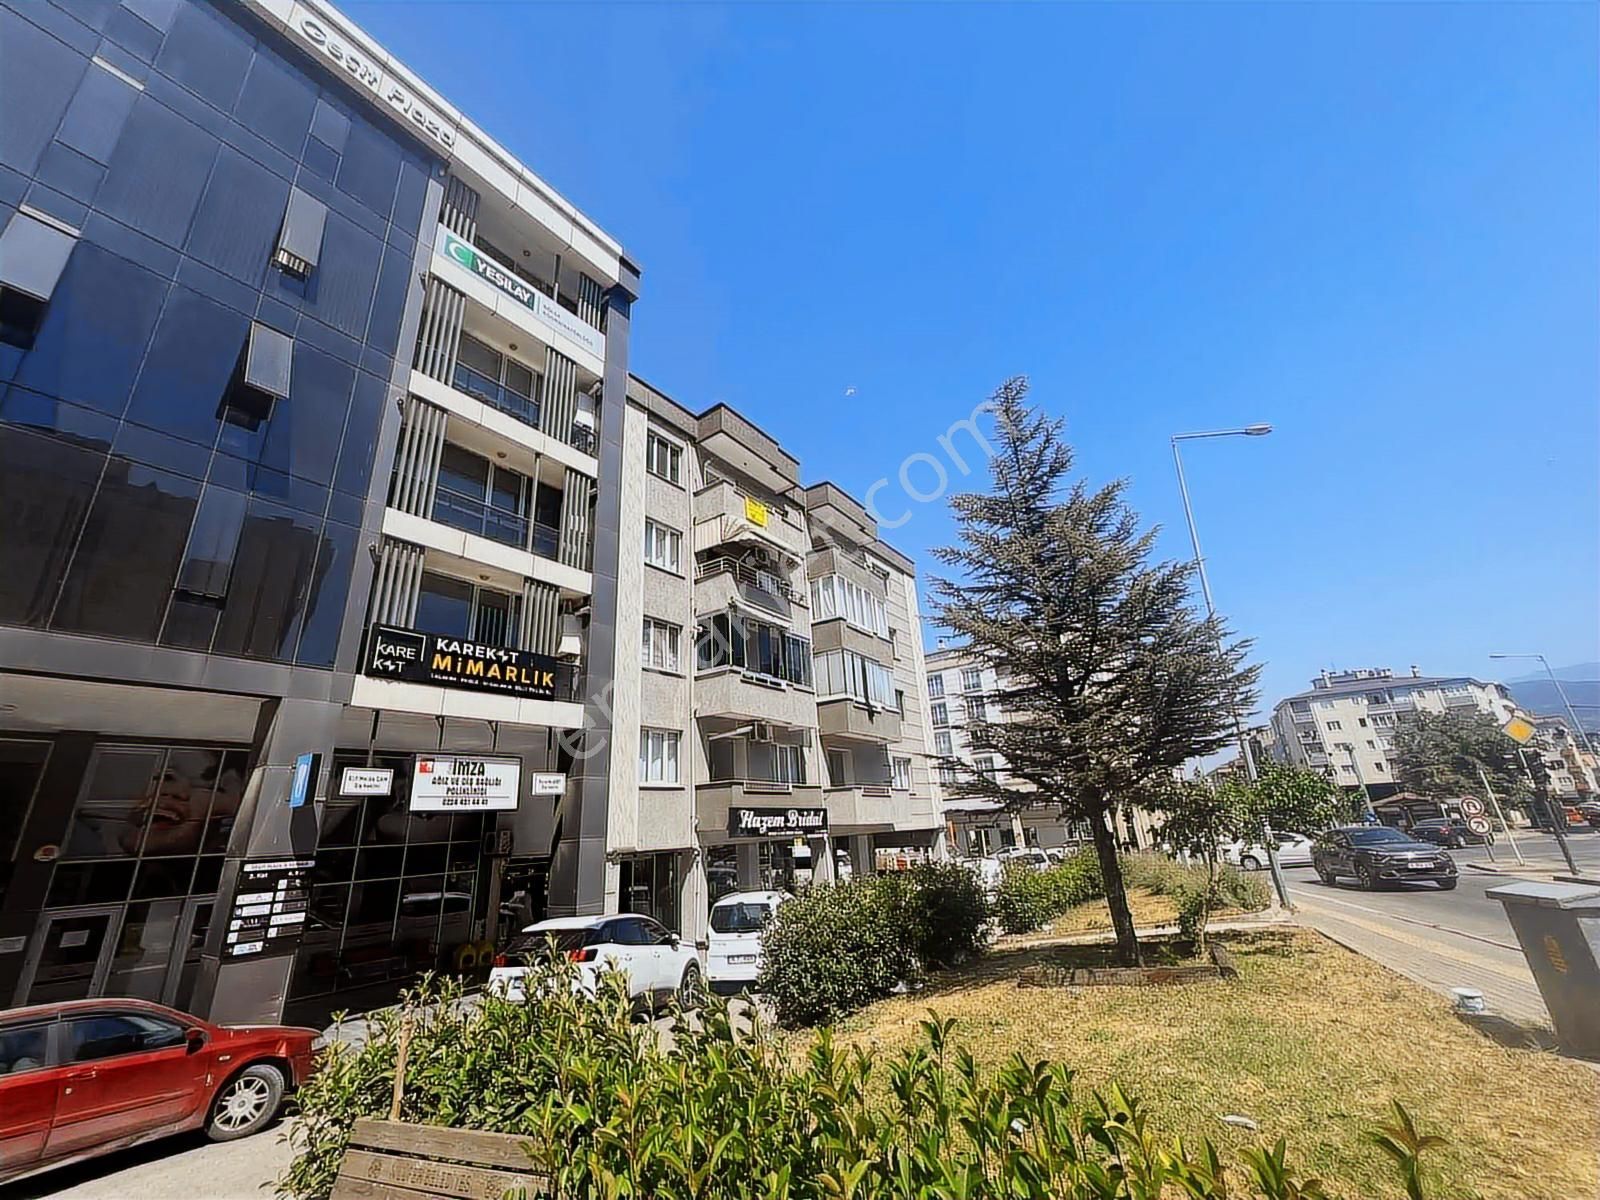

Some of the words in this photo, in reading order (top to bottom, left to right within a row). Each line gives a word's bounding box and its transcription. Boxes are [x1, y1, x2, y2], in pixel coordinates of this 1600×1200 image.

[387, 86, 455, 149] Plaza
[376, 643, 417, 660] KARE
[436, 637, 519, 664] KAREKT
[373, 658, 406, 673] KT
[739, 809, 785, 834] Hazem
[786, 809, 824, 828] Bridal
